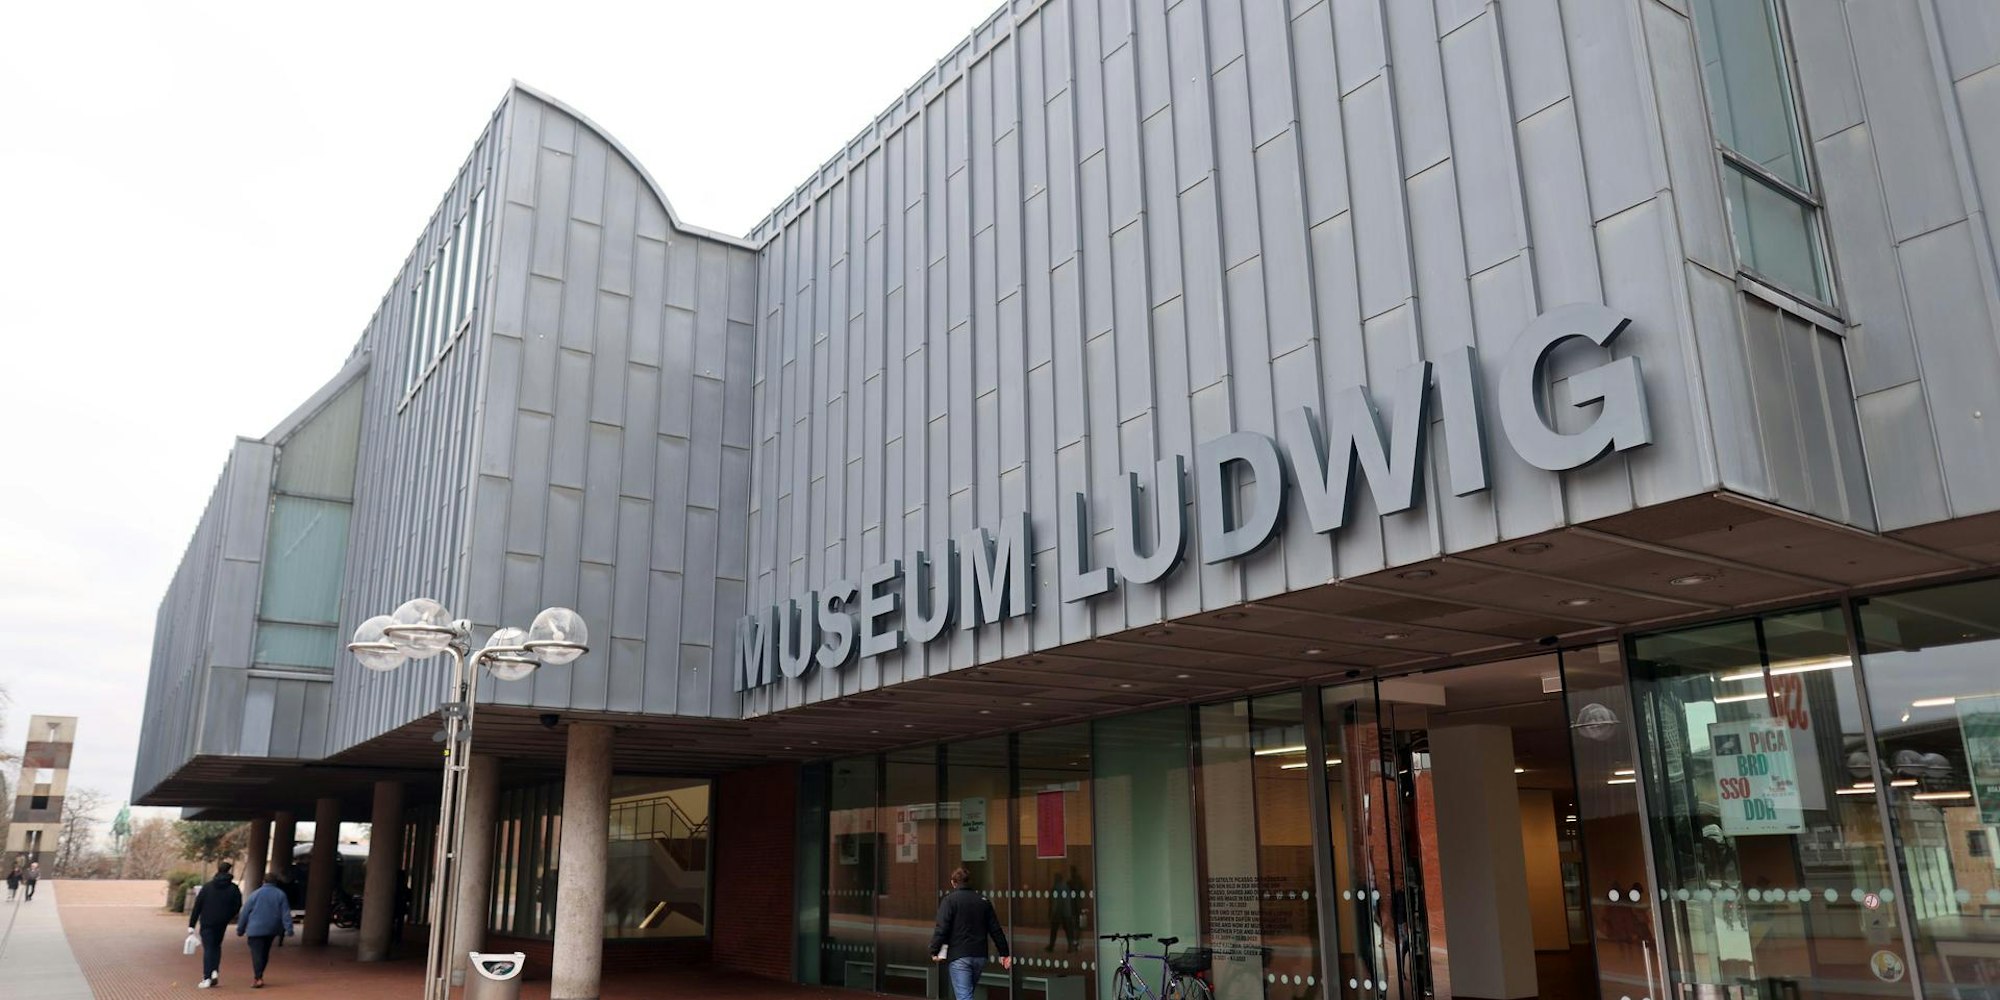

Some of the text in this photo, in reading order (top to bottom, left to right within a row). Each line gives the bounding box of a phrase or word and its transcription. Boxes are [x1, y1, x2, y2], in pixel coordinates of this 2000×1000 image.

[733, 302, 1653, 692] MUSEUM LUDWIG
[1750, 730, 1788, 753] PICA
[1737, 754, 1768, 776] BRD
[1719, 777, 1751, 800] SSO
[1744, 799, 1777, 821] DDR
